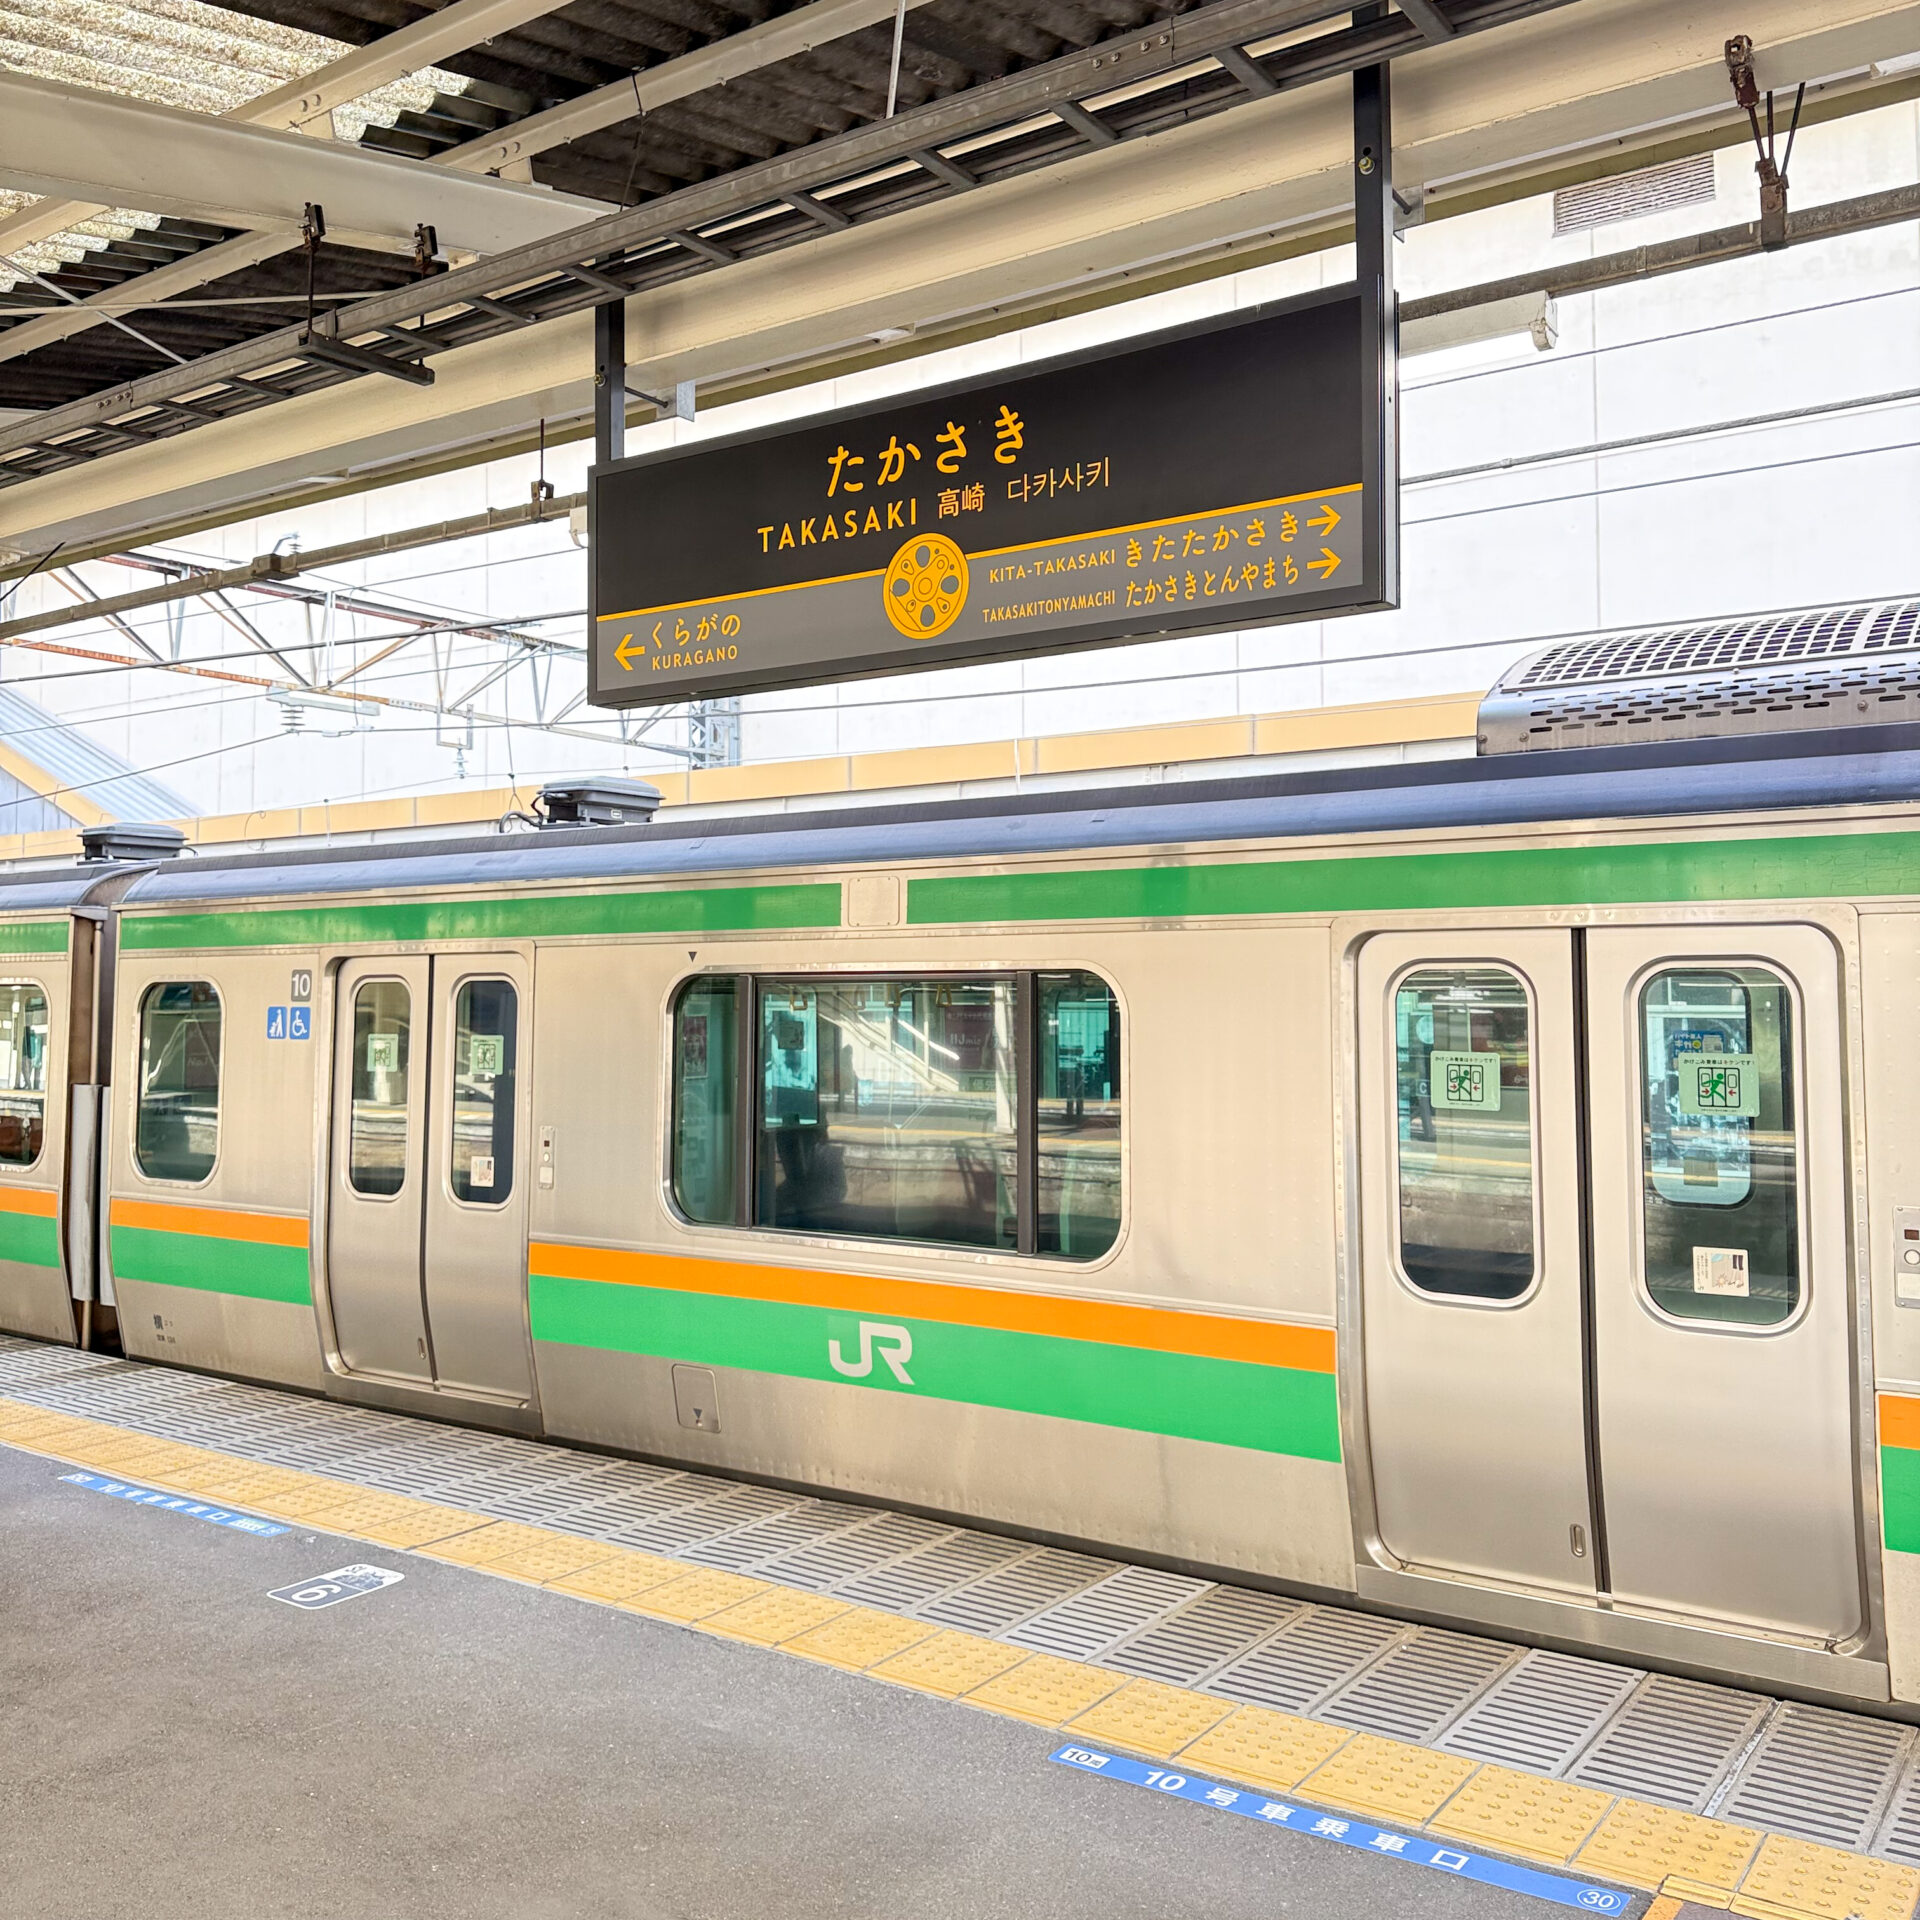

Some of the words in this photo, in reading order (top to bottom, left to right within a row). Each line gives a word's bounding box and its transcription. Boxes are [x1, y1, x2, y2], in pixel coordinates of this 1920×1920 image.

[827, 405, 1024, 498] たかさき
[1007, 456, 1111, 503] 다카사키
[937, 481, 986, 519] 高崎
[757, 498, 917, 553] TAKASAKI
[1125, 510, 1300, 568] きたたかさき
[989, 549, 1117, 584] KITA-TAKASAKI
[1125, 553, 1300, 608] たかさきとんやまち
[982, 590, 1116, 624] TAKASAKITONYAMACHI
[652, 613, 741, 649] くらがの
[651, 645, 739, 671] KURAGANO
[292, 974, 311, 997] 10
[828, 1320, 915, 1386] JR
[1583, 1891, 1615, 1909] 30
